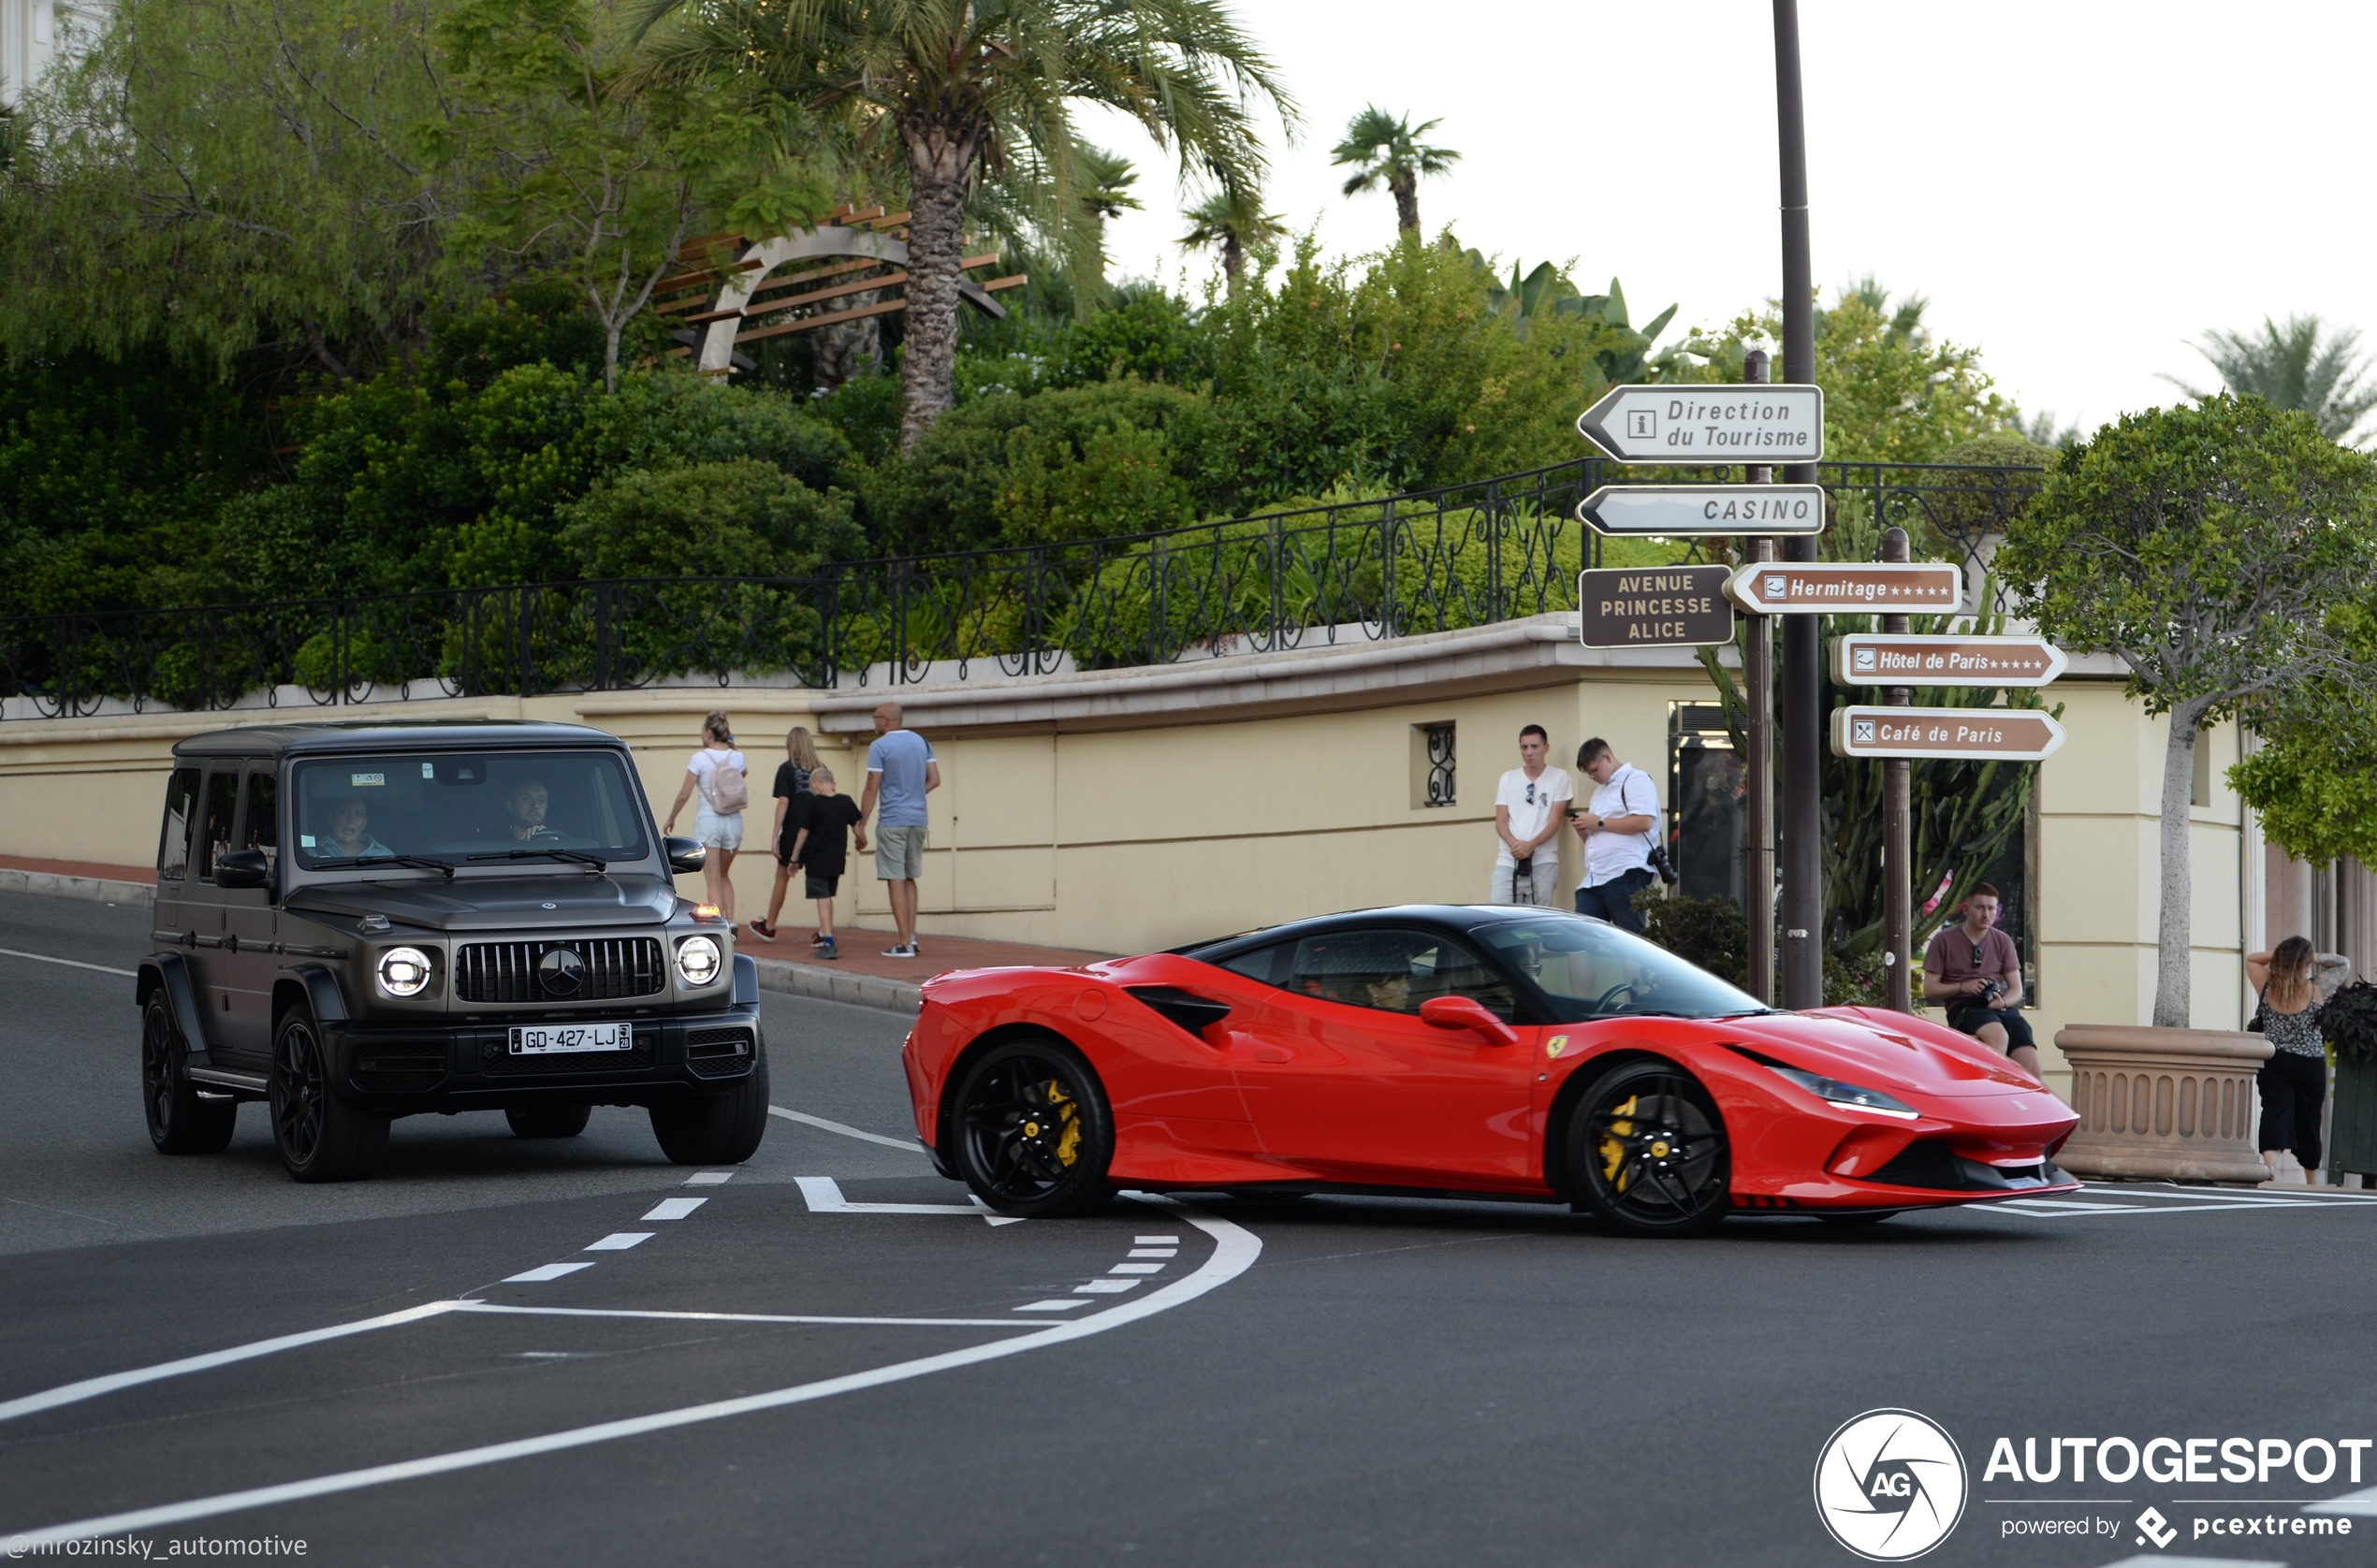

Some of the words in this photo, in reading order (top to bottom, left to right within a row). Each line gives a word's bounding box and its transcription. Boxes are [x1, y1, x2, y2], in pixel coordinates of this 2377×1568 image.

[1668, 399, 1789, 420] Direction
[1668, 428, 1694, 446] du
[1705, 427, 1807, 446] Tourisme
[1704, 500, 1809, 520] CASINO
[1618, 575, 1694, 592] AVENUE
[1790, 579, 1887, 601] Hermitage
[1601, 598, 1712, 616] PRINCESSE
[1628, 622, 1685, 639] ALICE
[1879, 652, 1919, 669] Hôtel
[1925, 653, 1944, 669] de
[1948, 653, 1989, 670] Paris
[1880, 724, 1920, 741] Café
[1929, 726, 1948, 742] de
[1957, 728, 2003, 743] Paris
[526, 1028, 616, 1048] GD-427-LJ
